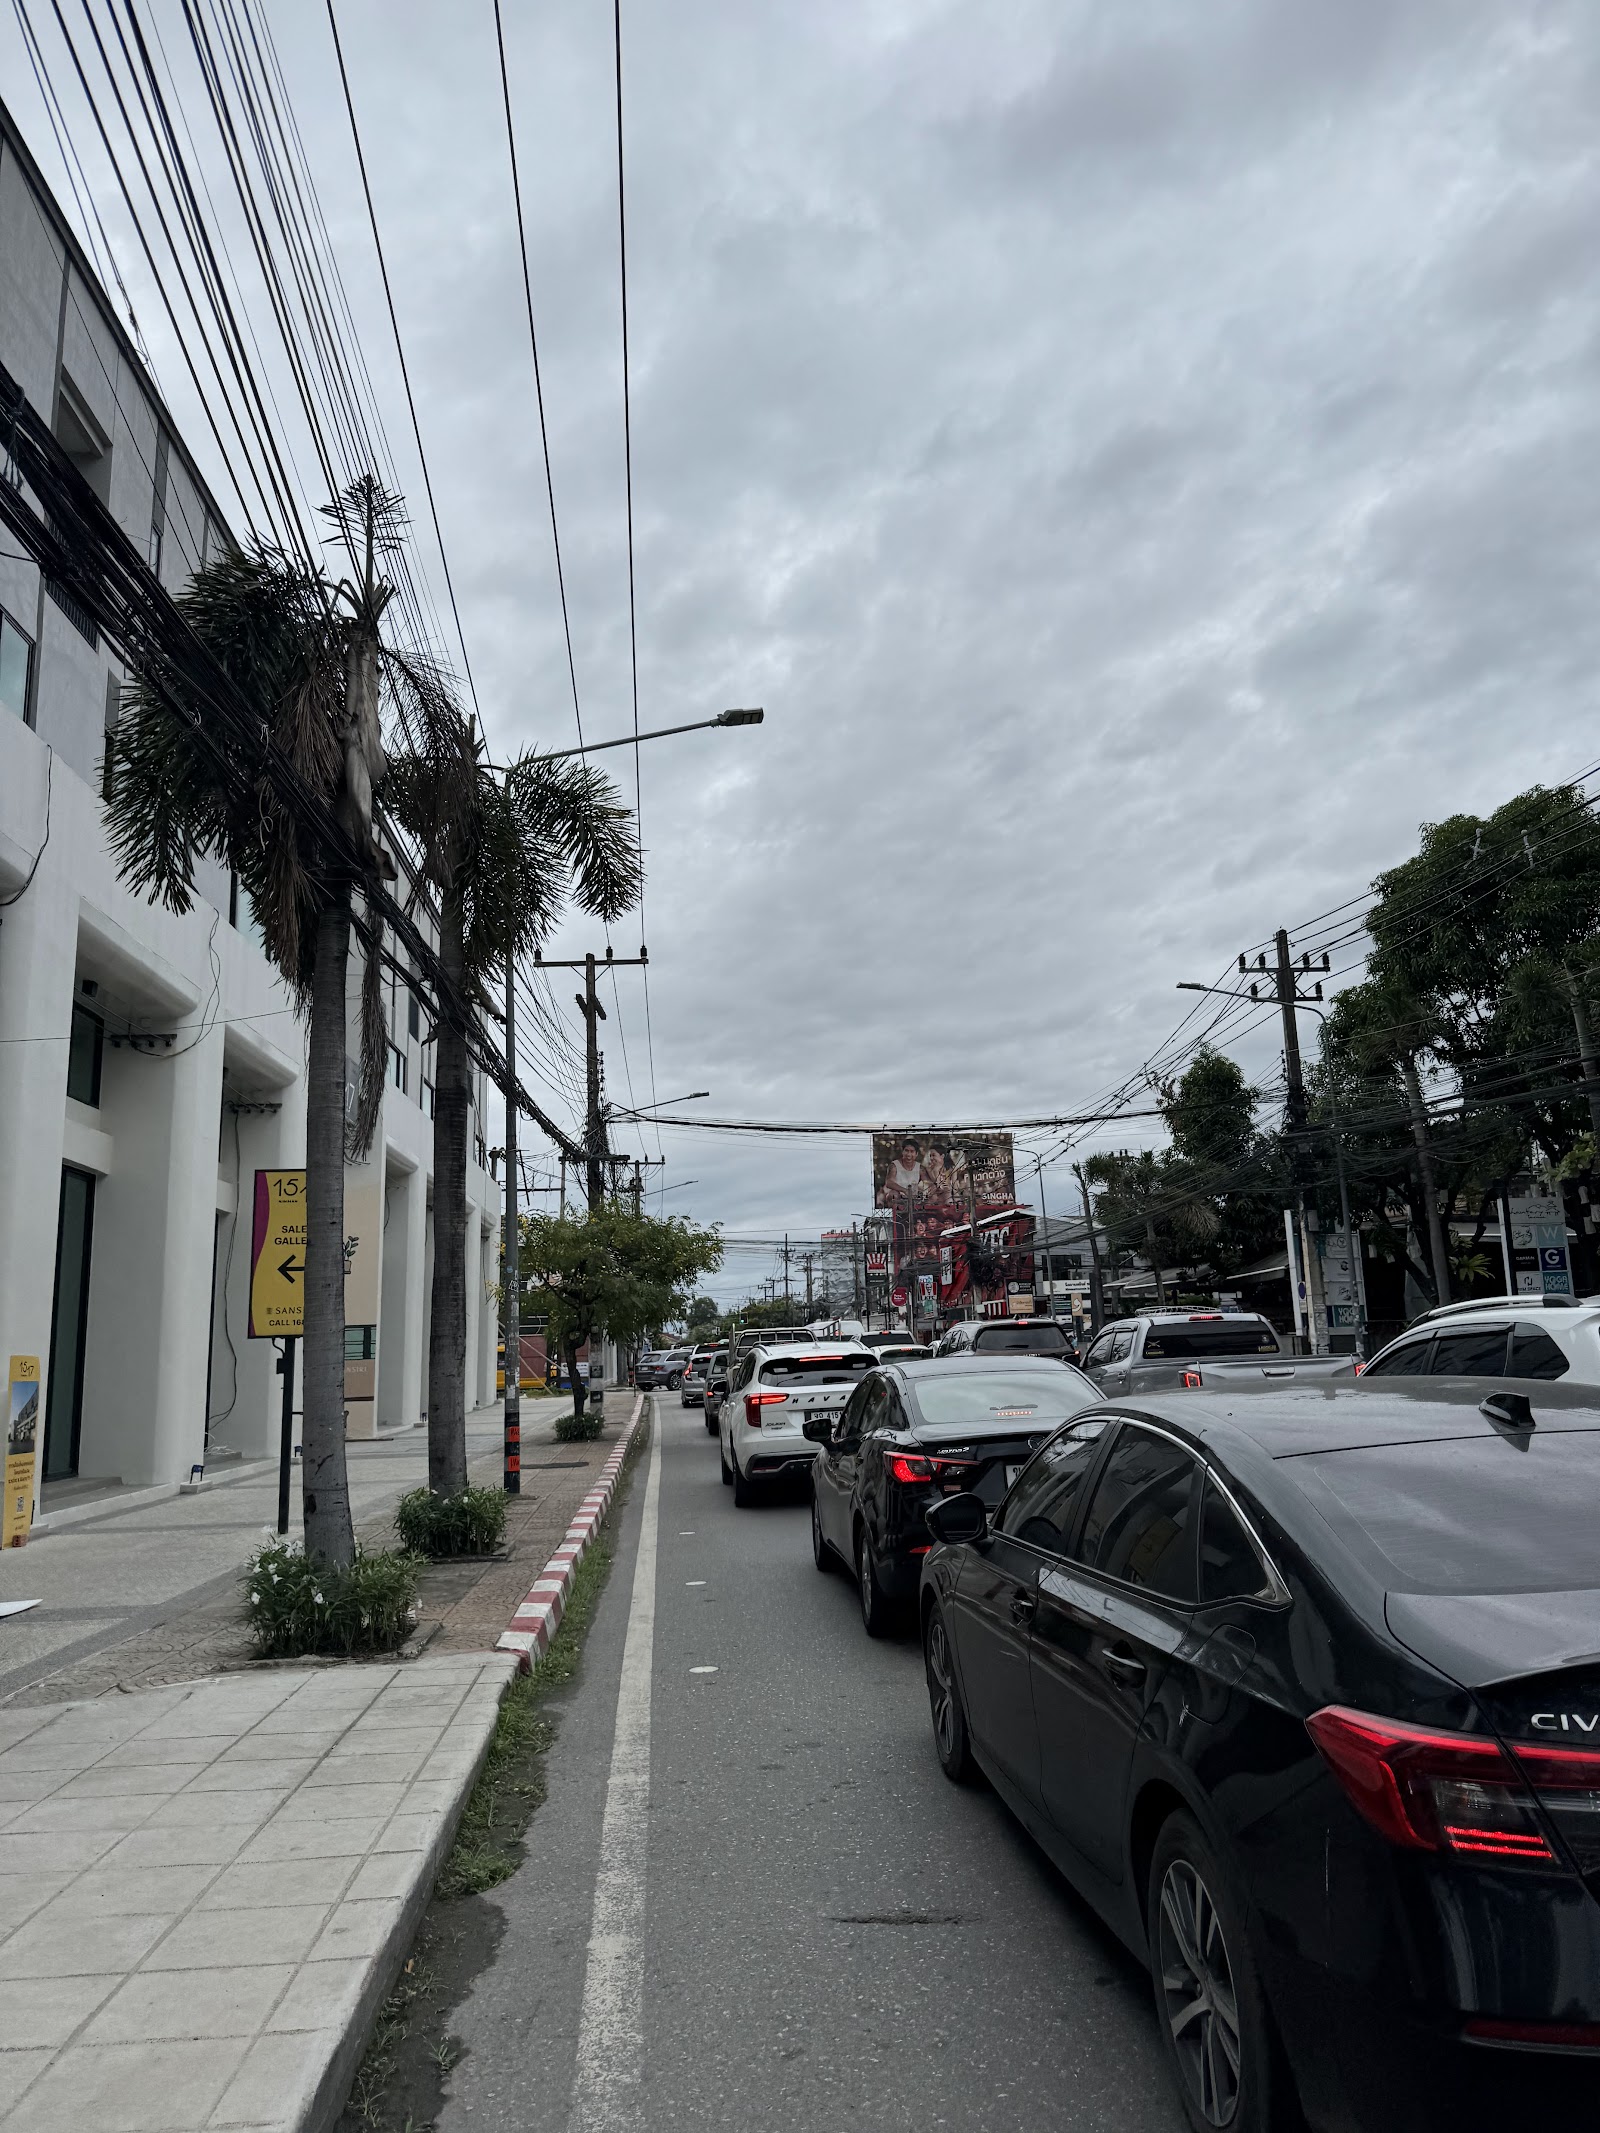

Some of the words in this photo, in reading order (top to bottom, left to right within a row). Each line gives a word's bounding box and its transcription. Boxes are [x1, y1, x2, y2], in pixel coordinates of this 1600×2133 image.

[273, 1178, 306, 1196] 15
[982, 1192, 1014, 1200] SINGHA
[1542, 1226, 1559, 1240] W
[1544, 1248, 1560, 1265] G
[1544, 1275, 1568, 1284] YOGA
[1545, 1283, 1570, 1292] HOME
[1530, 1712, 1600, 1733] CIV
